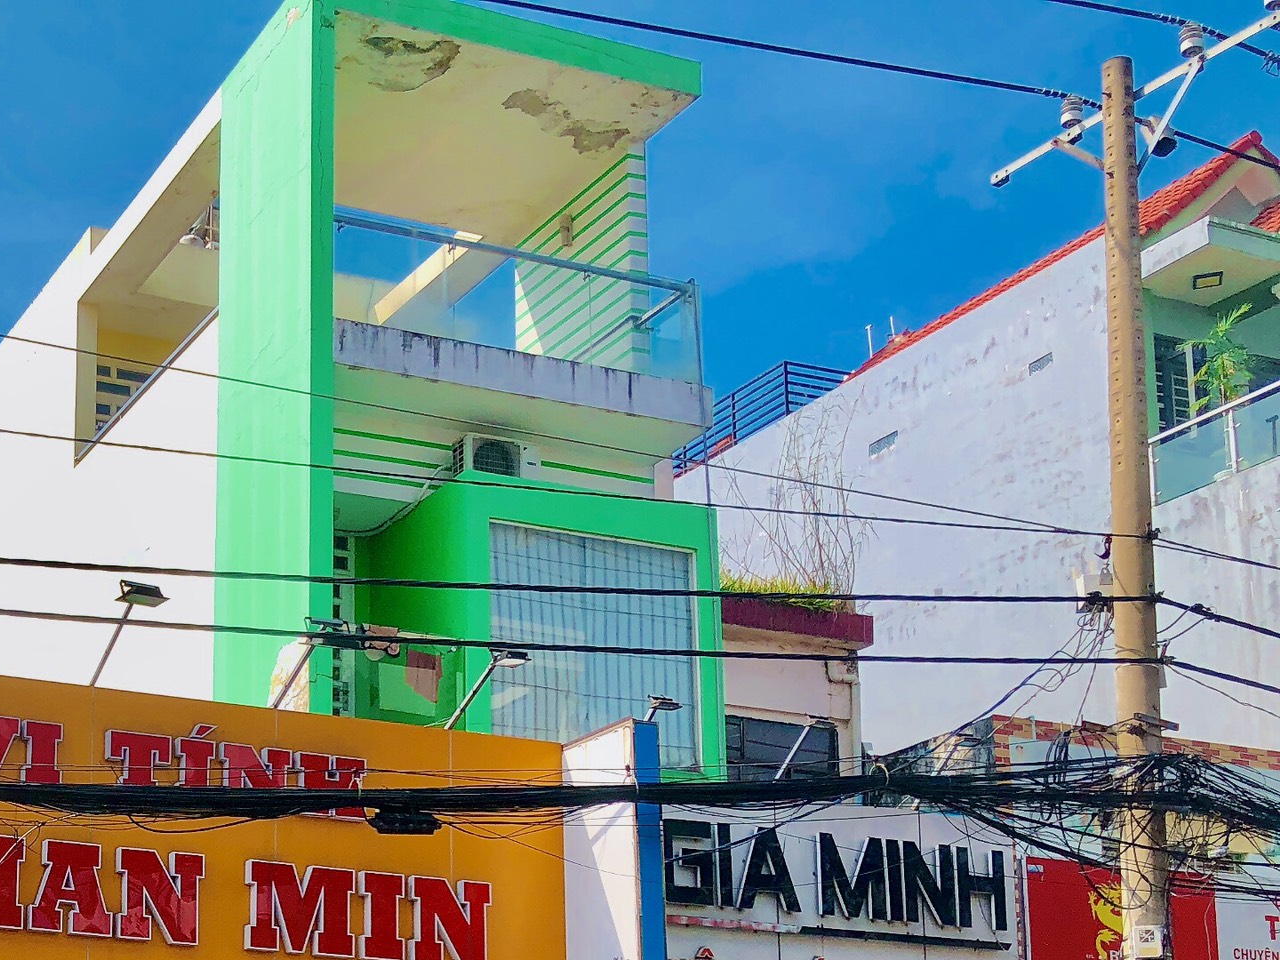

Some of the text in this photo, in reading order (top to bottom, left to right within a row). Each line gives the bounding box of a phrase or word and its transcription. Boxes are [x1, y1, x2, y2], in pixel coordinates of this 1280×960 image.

[104, 723, 367, 821] TÍNH
[663, 818, 1008, 932] GIA MINH
